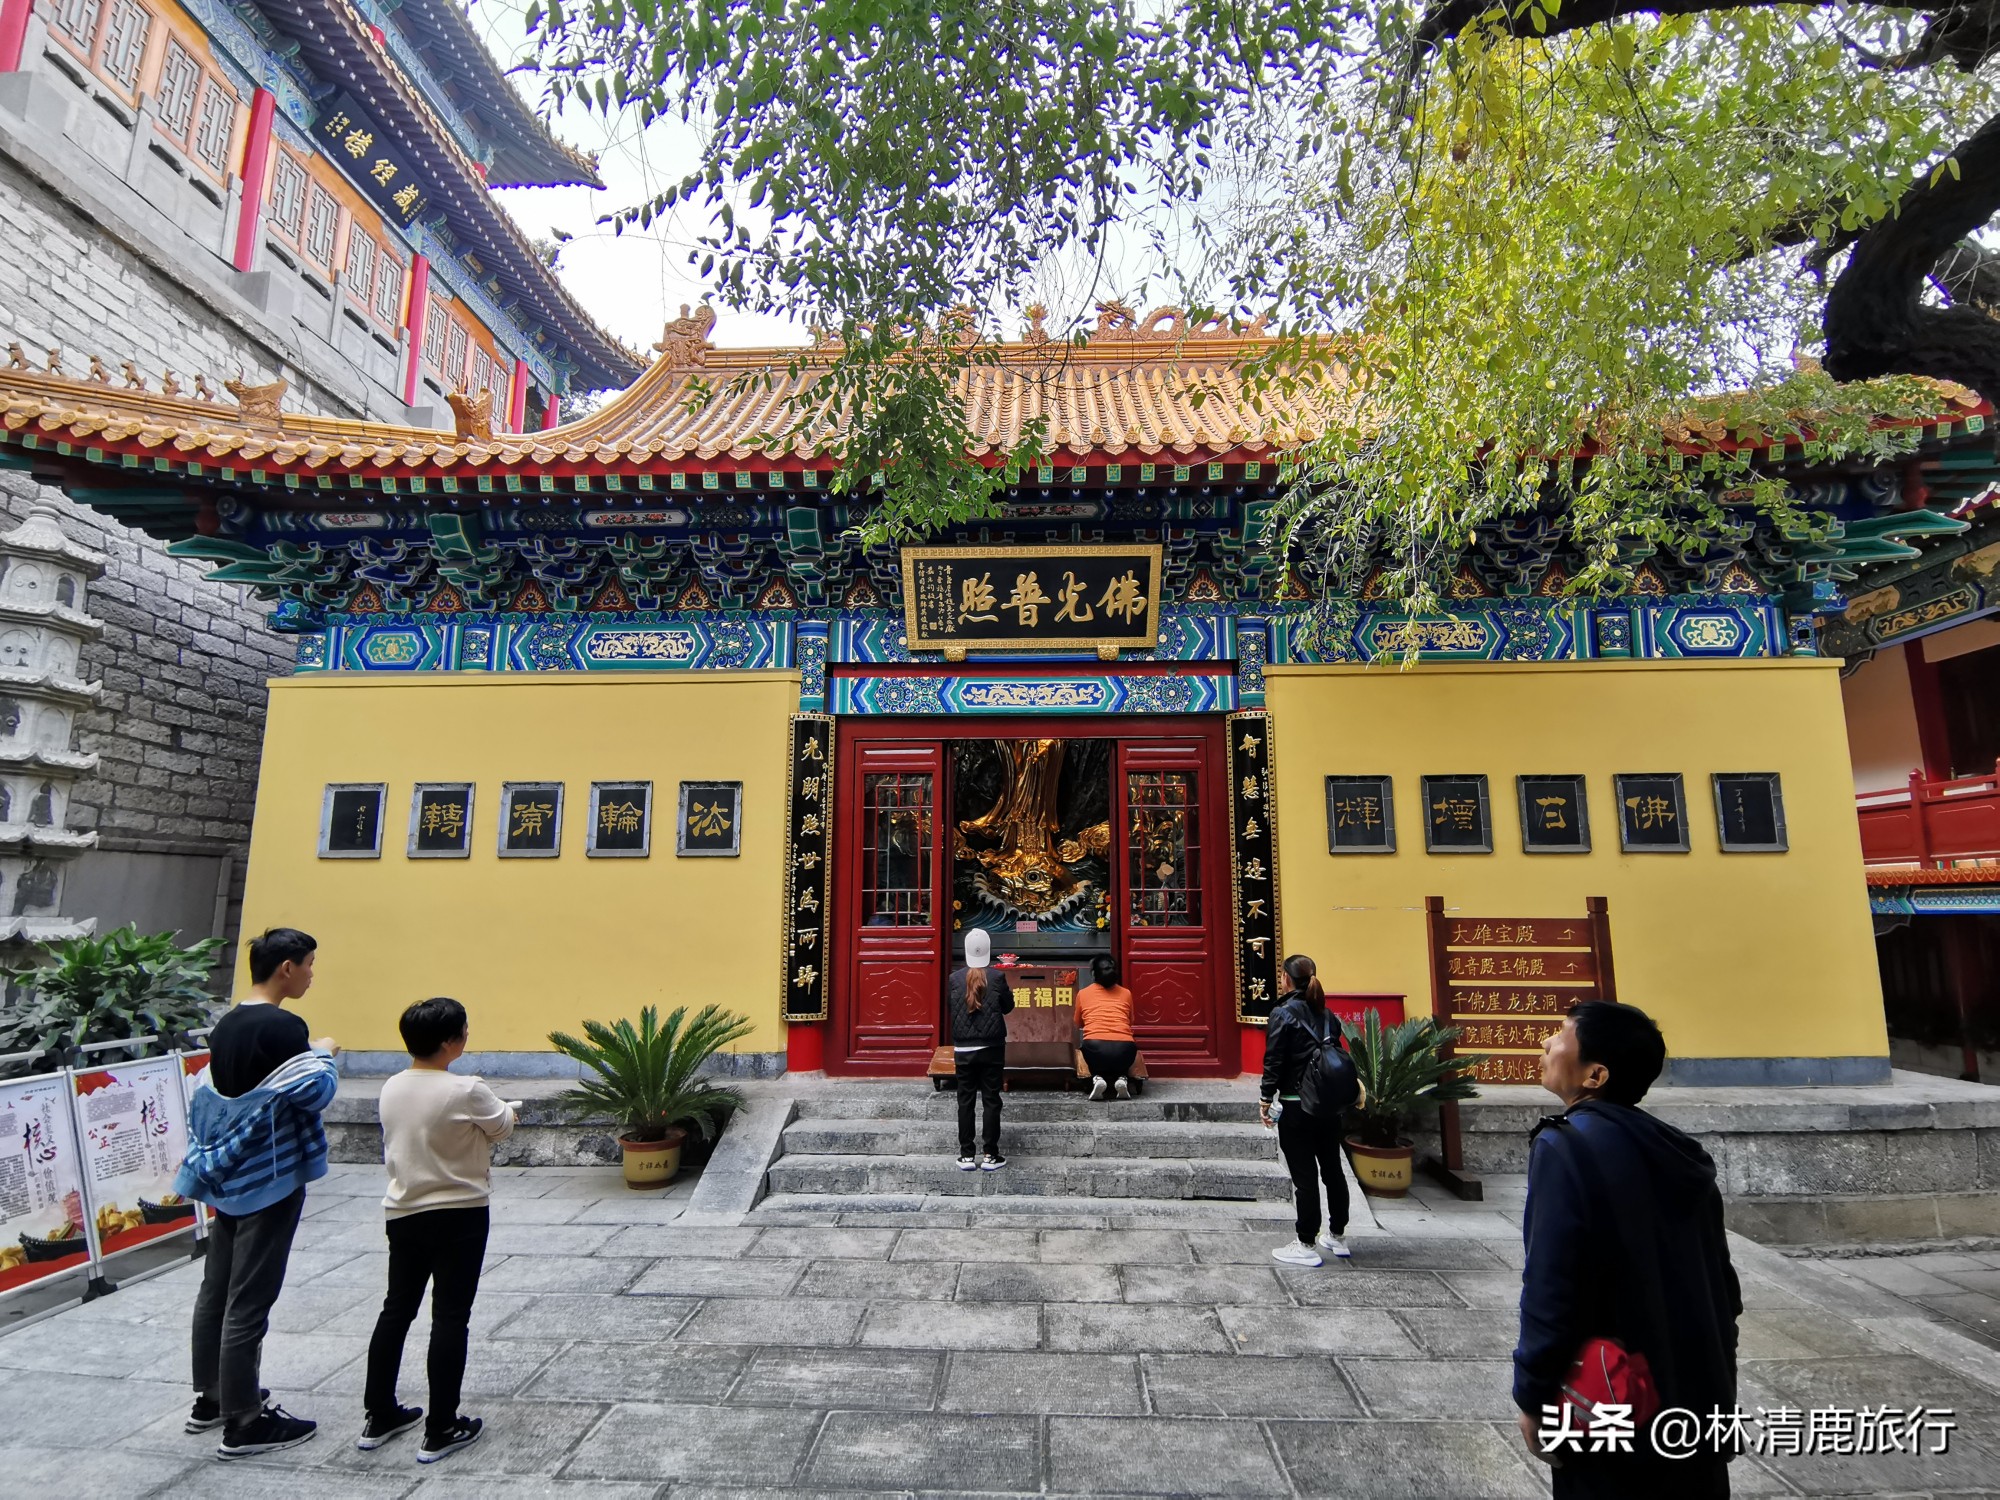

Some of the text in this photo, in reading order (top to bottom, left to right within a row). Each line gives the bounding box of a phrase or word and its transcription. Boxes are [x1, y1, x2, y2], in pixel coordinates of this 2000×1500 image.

[958, 569, 1148, 628] 佛光普照
[1452, 923, 1538, 945] 大雄宝殿
[1012, 986, 1074, 1008] 種福田
